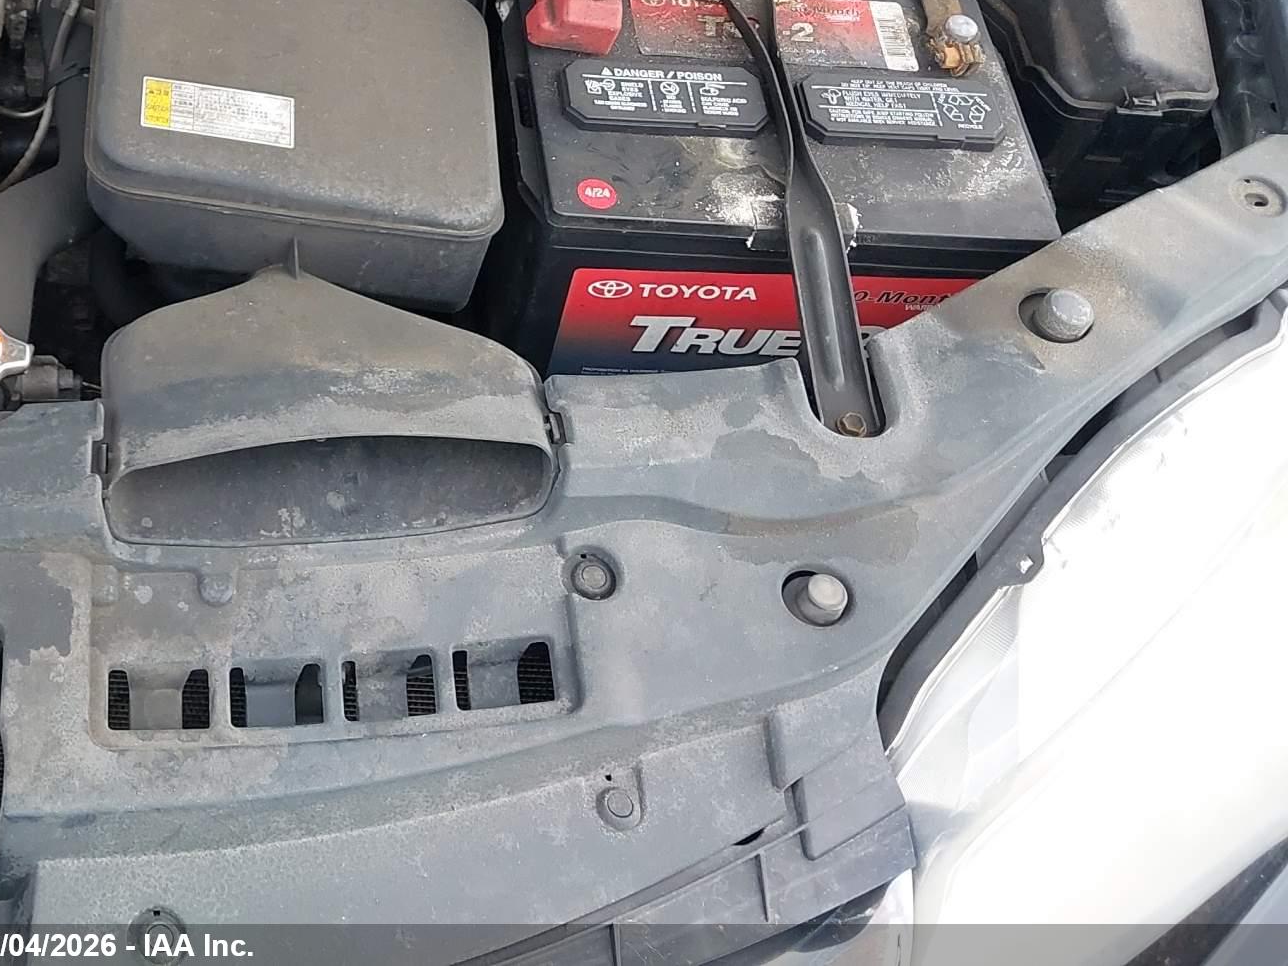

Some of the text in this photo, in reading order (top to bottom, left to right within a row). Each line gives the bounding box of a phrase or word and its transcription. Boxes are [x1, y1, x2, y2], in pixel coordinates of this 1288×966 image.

[613, 68, 665, 79] DANGER
[677, 71, 723, 81] POISON
[584, 186, 611, 198] 4/24
[639, 283, 758, 301] TOYOTA
